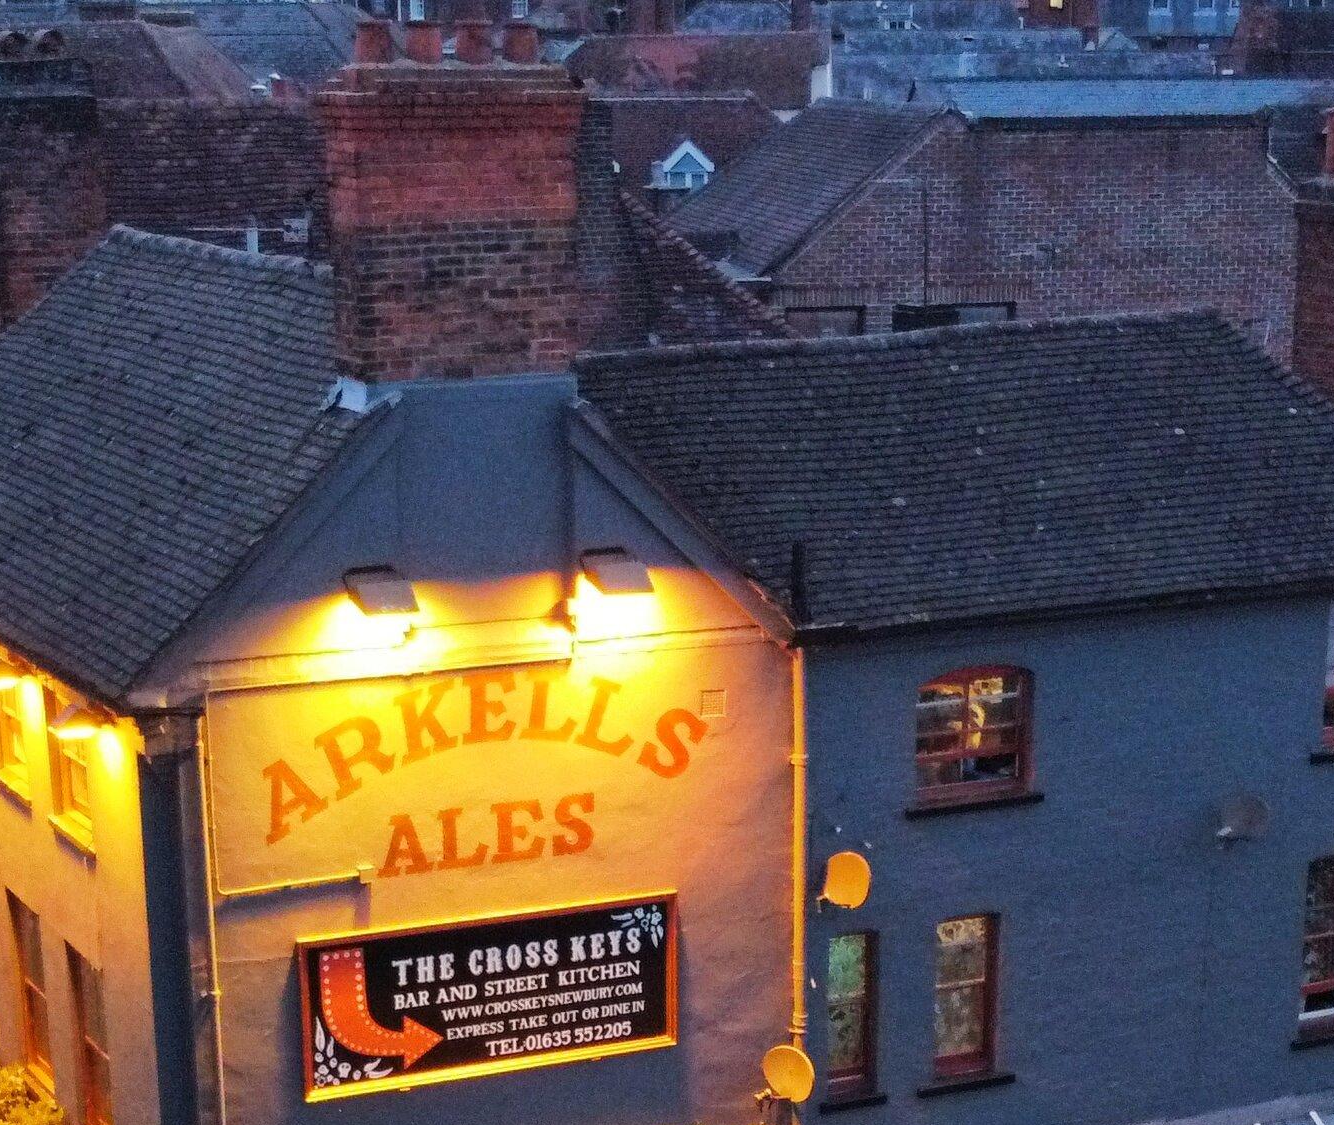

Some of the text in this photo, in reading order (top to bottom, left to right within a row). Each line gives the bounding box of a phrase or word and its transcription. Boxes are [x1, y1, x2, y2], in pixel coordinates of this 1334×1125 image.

[263, 669, 710, 845] ARKELLS
[377, 792, 595, 878] ALES
[392, 926, 642, 987] THE CROSS KEYS
[393, 960, 641, 1011] BAR AND STREET KITCHEN
[446, 999, 645, 1041] EXPRESS TAKE OUT OR DINE IN
[574, 1021, 632, 1045] 552205
